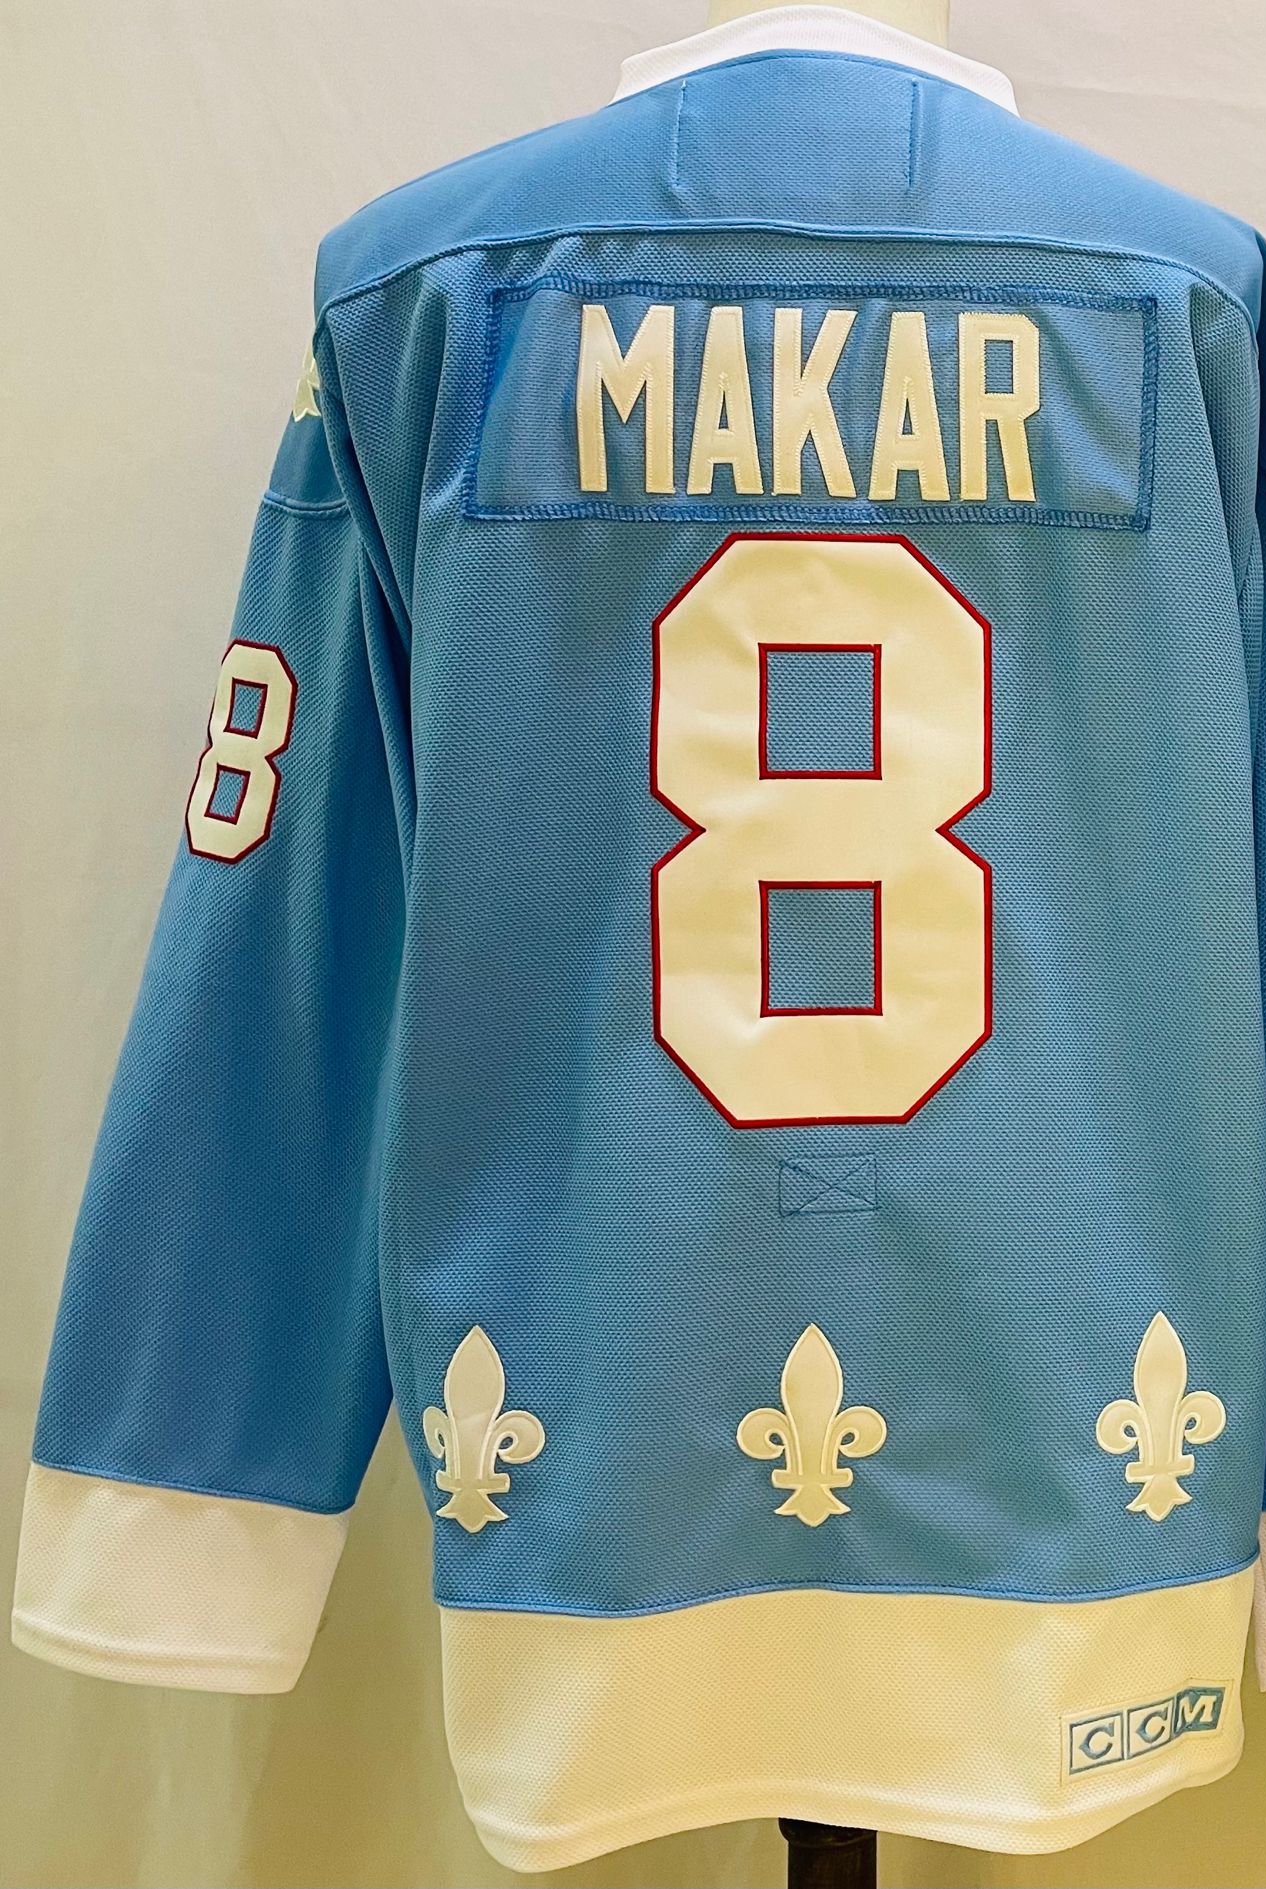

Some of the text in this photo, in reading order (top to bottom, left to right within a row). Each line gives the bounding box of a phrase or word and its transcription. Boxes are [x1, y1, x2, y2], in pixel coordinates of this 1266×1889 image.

[577, 304, 1042, 502] MAKAR
[185, 638, 298, 865] 8
[650, 532, 992, 1129] 8
[1076, 1692, 1220, 1764] CCM
